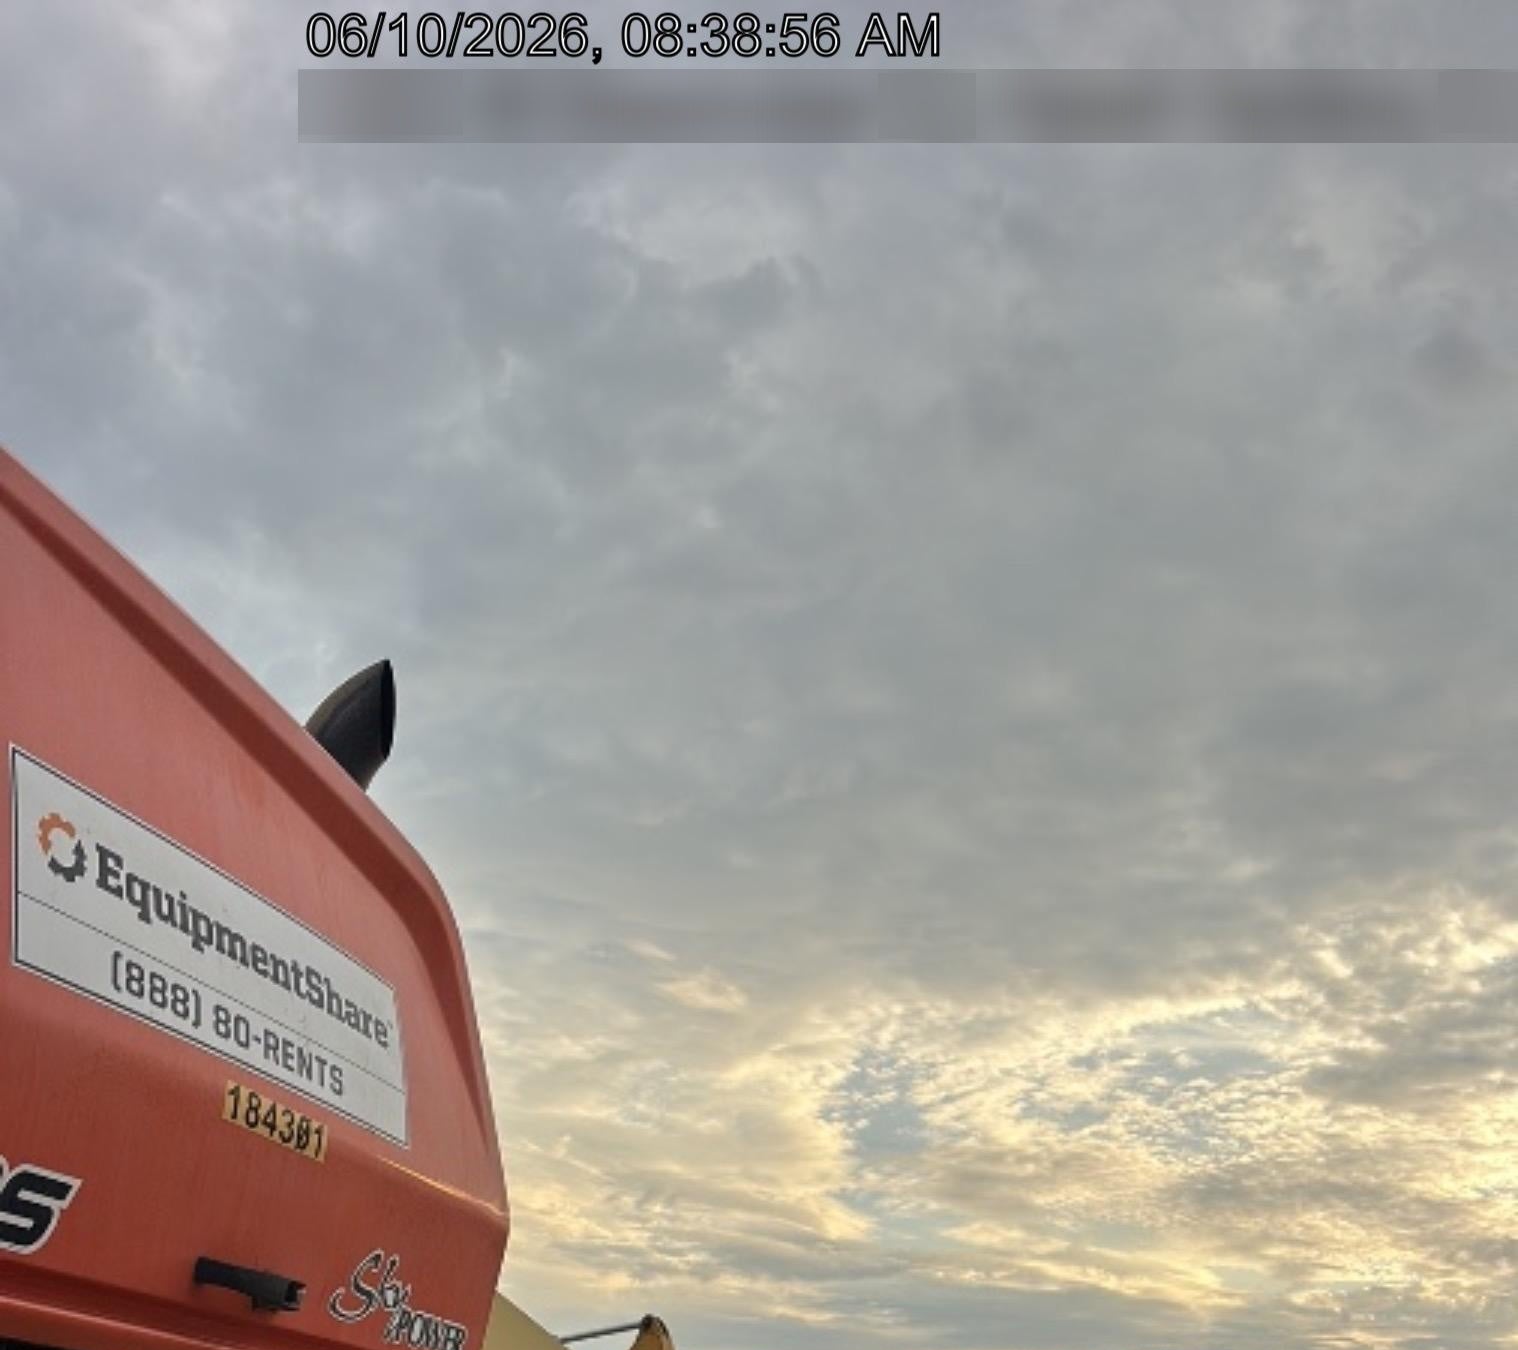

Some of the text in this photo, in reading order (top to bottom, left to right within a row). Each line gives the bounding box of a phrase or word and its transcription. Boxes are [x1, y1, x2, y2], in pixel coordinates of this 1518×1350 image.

[95, 843, 390, 1049] EquipmentShare
[110, 950, 345, 1096] (888) 80-RENTS
